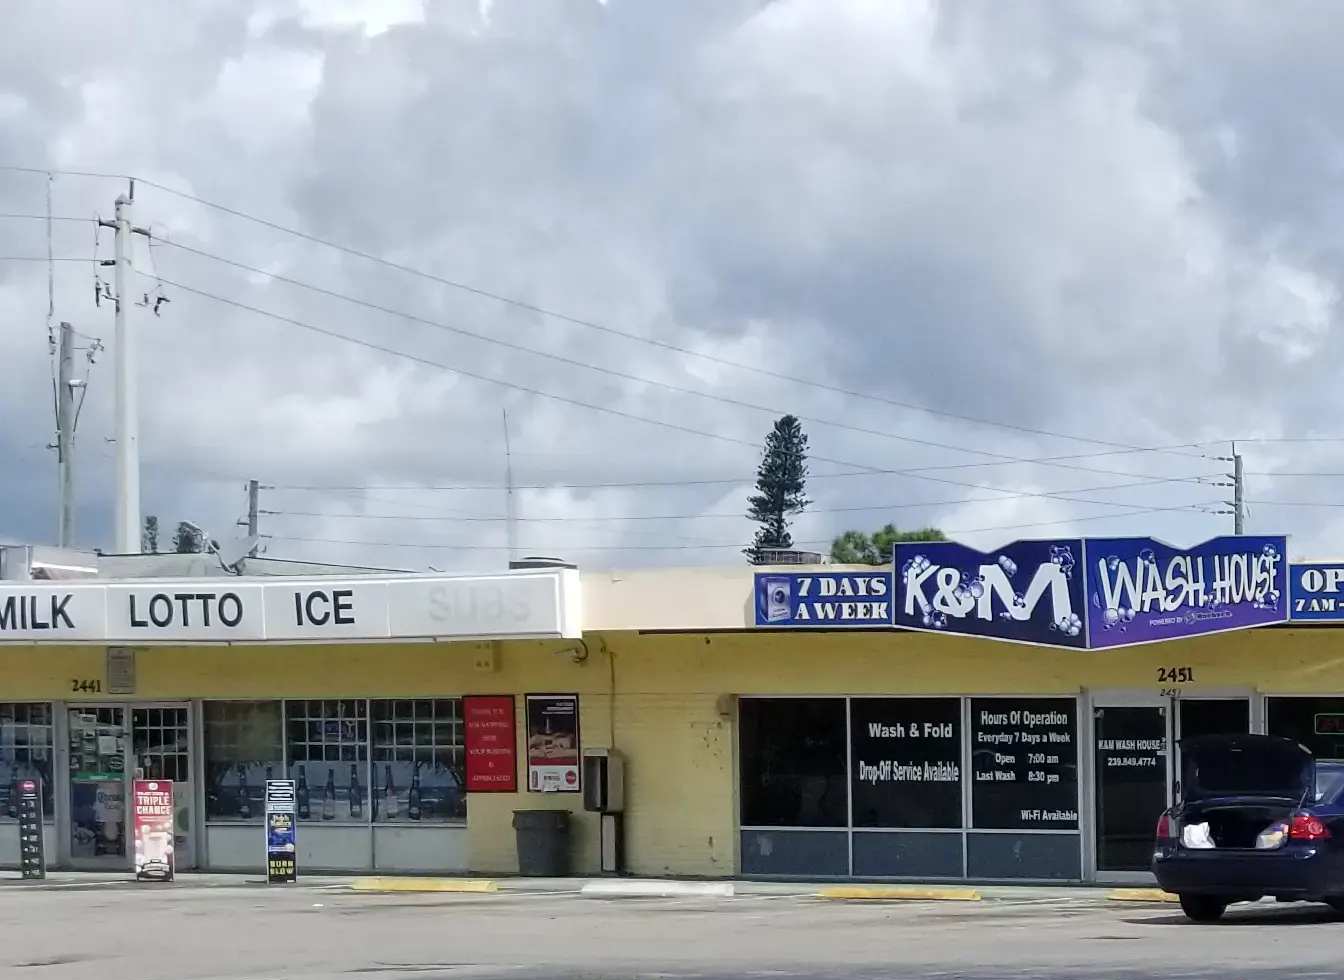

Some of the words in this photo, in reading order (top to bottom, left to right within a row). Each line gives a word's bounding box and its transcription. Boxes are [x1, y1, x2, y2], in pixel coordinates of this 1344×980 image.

[797, 577, 813, 597] 7
[817, 577, 887, 597] DAYS
[1099, 555, 1203, 614] WASH
[1213, 552, 1282, 605] HOUSE
[904, 562, 1073, 626] K&M
[129, 592, 244, 628] LOTTO
[294, 589, 355, 627] ICE
[793, 602, 811, 620] A
[812, 602, 889, 620] WEEK
[1294, 598, 1307, 612] 7
[1308, 598, 1336, 612] AM
[1157, 666, 1195, 683] 2451
[72, 679, 102, 693] 2441
[980, 710, 1008, 725] Hours
[1009, 710, 1021, 725] Of
[1023, 710, 1068, 728] Operation
[868, 722, 905, 738] Wash
[909, 722, 920, 738] &
[923, 722, 953, 738] Fold
[977, 731, 1013, 745] Everyday
[1014, 731, 1020, 743] 7
[1021, 731, 1041, 745] Days
[1049, 732, 1071, 743] Week
[1115, 739, 1136, 750] WASH
[1136, 739, 1161, 750] HOUSE
[995, 752, 1016, 766] Open
[1046, 755, 1059, 764] am
[859, 760, 892, 786] Drop-Off
[892, 760, 922, 781] Service
[923, 760, 959, 782] Available
[976, 770, 994, 781] Last
[994, 770, 1016, 781] Wash
[1046, 774, 1060, 785] pm
[138, 796, 171, 806] TRIPLE
[136, 805, 171, 815] CHANCE
[1020, 809, 1041, 821] Wi-Fi
[1042, 809, 1078, 821] Available
